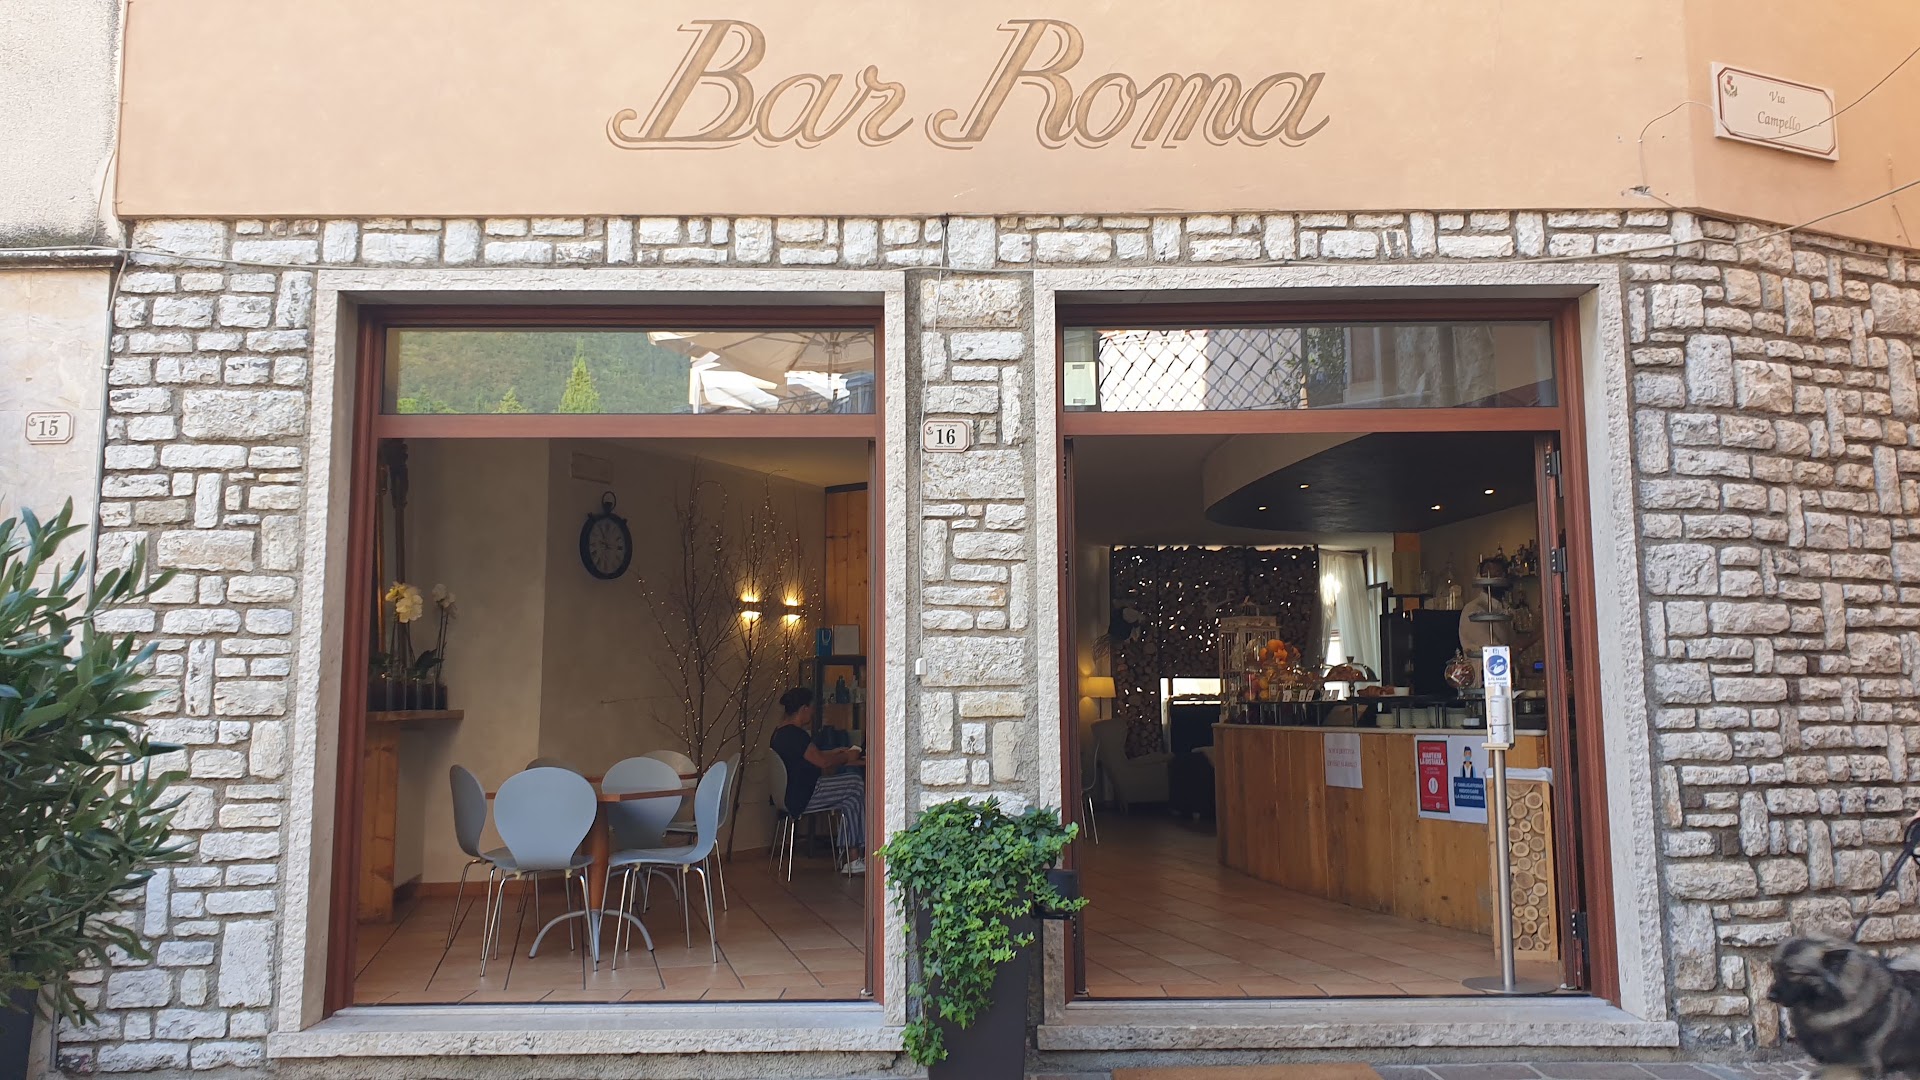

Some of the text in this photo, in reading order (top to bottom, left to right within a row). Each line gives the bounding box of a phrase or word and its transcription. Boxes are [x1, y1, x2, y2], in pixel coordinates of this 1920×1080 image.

[607, 20, 1330, 150] Bar Roma
[1768, 91, 1786, 104] Via
[1757, 111, 1801, 133] Campello
[39, 419, 59, 436] 15
[936, 428, 956, 445] 16
